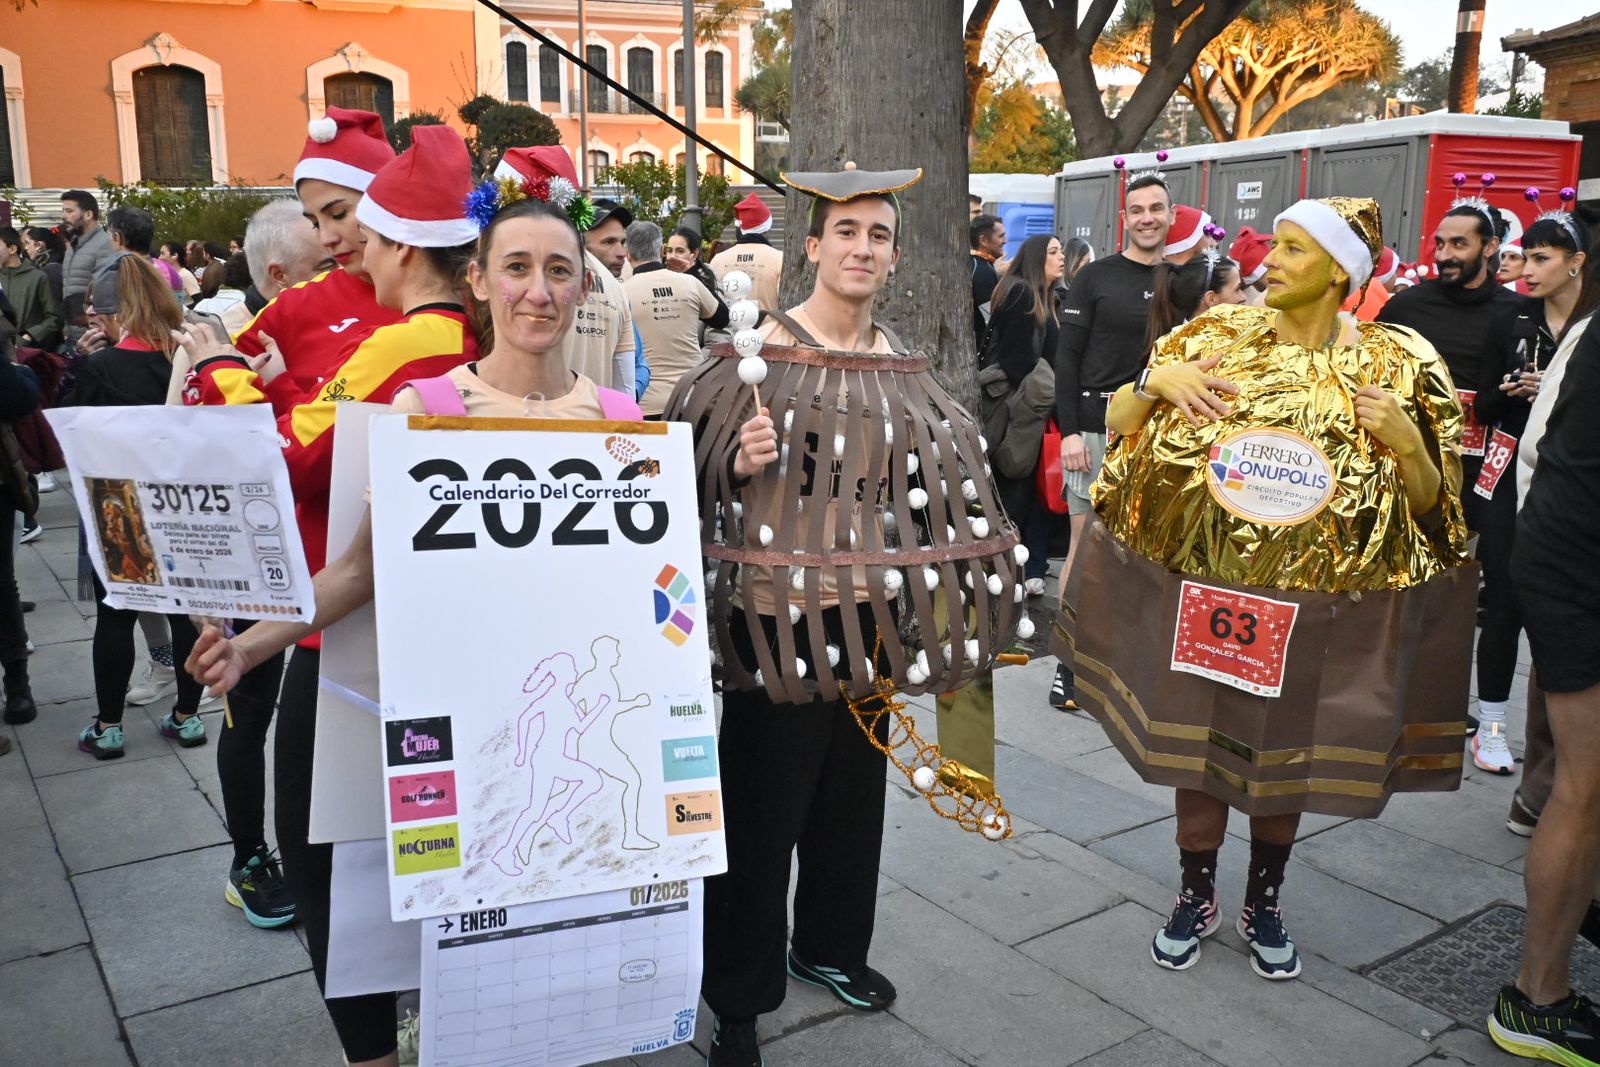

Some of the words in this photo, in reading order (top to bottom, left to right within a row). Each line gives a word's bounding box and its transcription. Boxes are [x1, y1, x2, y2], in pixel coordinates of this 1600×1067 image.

[1247, 186, 1261, 194] AWC
[736, 254, 754, 262] RUN
[652, 286, 674, 298] RUN
[1242, 442, 1312, 468] FERRERO
[1239, 460, 1328, 490] ONUPOLIS
[148, 484, 231, 513] 30125
[429, 483, 535, 501] Calendario
[540, 483, 568, 499] Del
[572, 482, 651, 499] Corredor
[1246, 484, 1282, 496] CIRCUITO
[1284, 491, 1318, 502] POPULAR
[407, 457, 670, 552] 2026
[1260, 494, 1302, 508] DEPORTIVO
[151, 521, 190, 531] LOTERÍA
[191, 524, 242, 533] NACIONAL
[267, 567, 283, 580] 20
[1210, 607, 1258, 645] 63
[1222, 642, 1242, 651] DAVID
[1195, 642, 1234, 658] GONZALEZ
[1236, 653, 1265, 668] GARCIA
[670, 704, 702, 718] HUELVA
[407, 739, 440, 752] MUJER
[674, 746, 704, 759] VUELTA
[398, 837, 455, 856] NOCTURNA
[630, 880, 689, 906] 01/2026
[460, 908, 508, 933] ENERO
[632, 1039, 669, 1053] HUELVA
